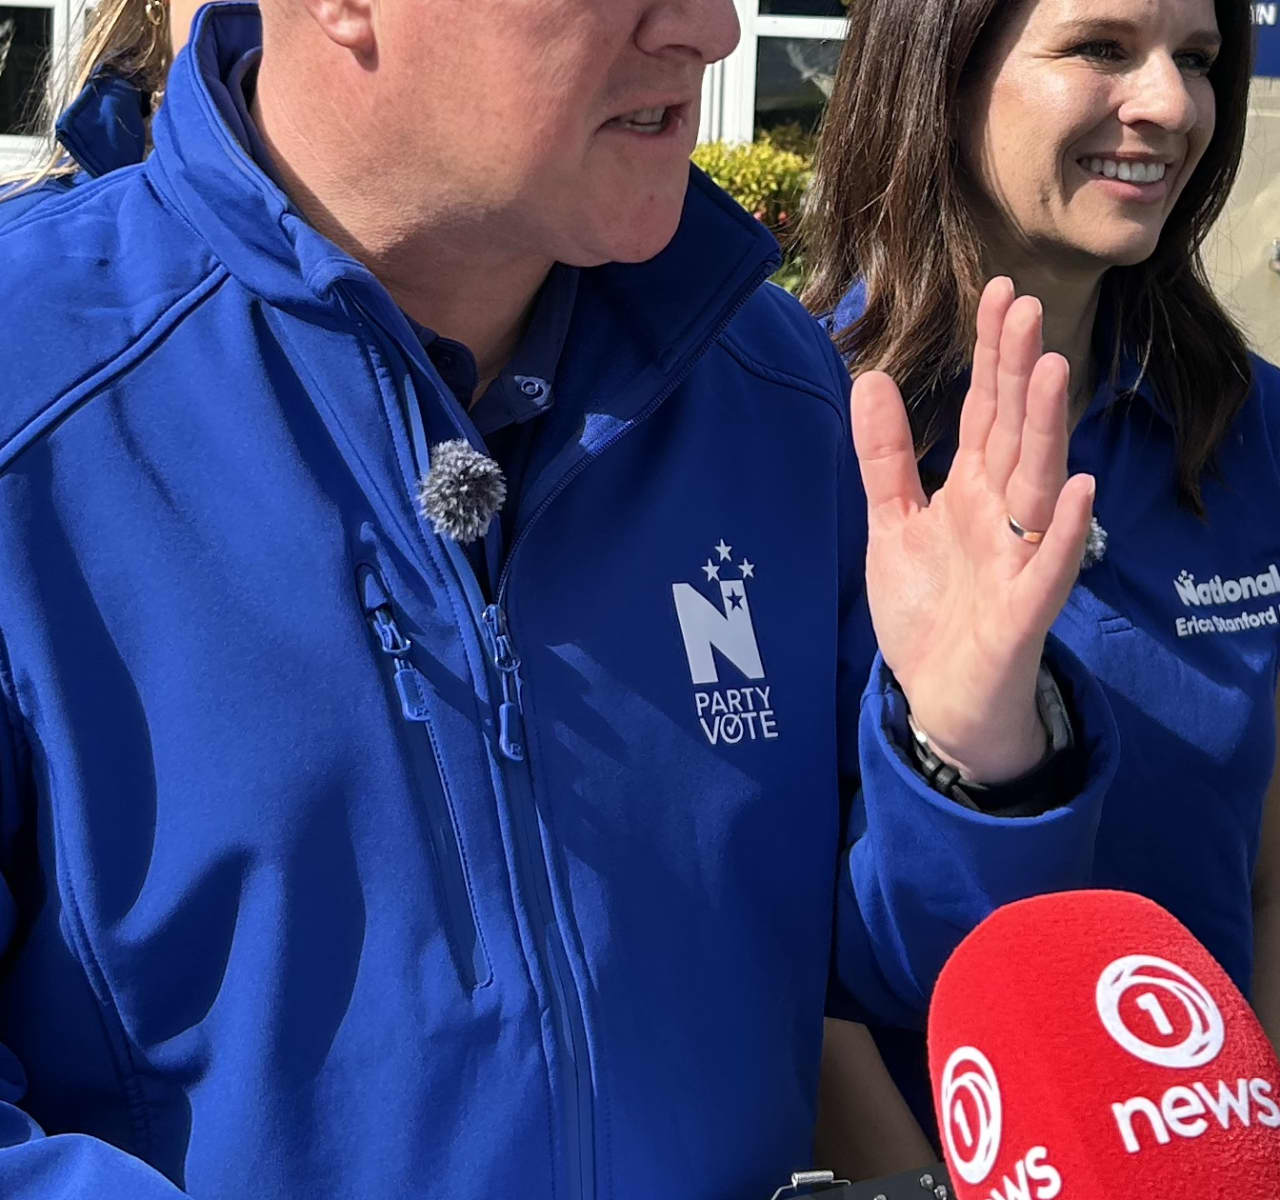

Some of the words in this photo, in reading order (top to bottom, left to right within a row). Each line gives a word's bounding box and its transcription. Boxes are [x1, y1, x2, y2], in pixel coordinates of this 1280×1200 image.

[672, 579, 765, 684] N
[1175, 616, 1215, 637] Erica
[1213, 606, 1278, 633] Stanford
[695, 686, 771, 716] PARTY
[700, 710, 779, 745] VOTE
